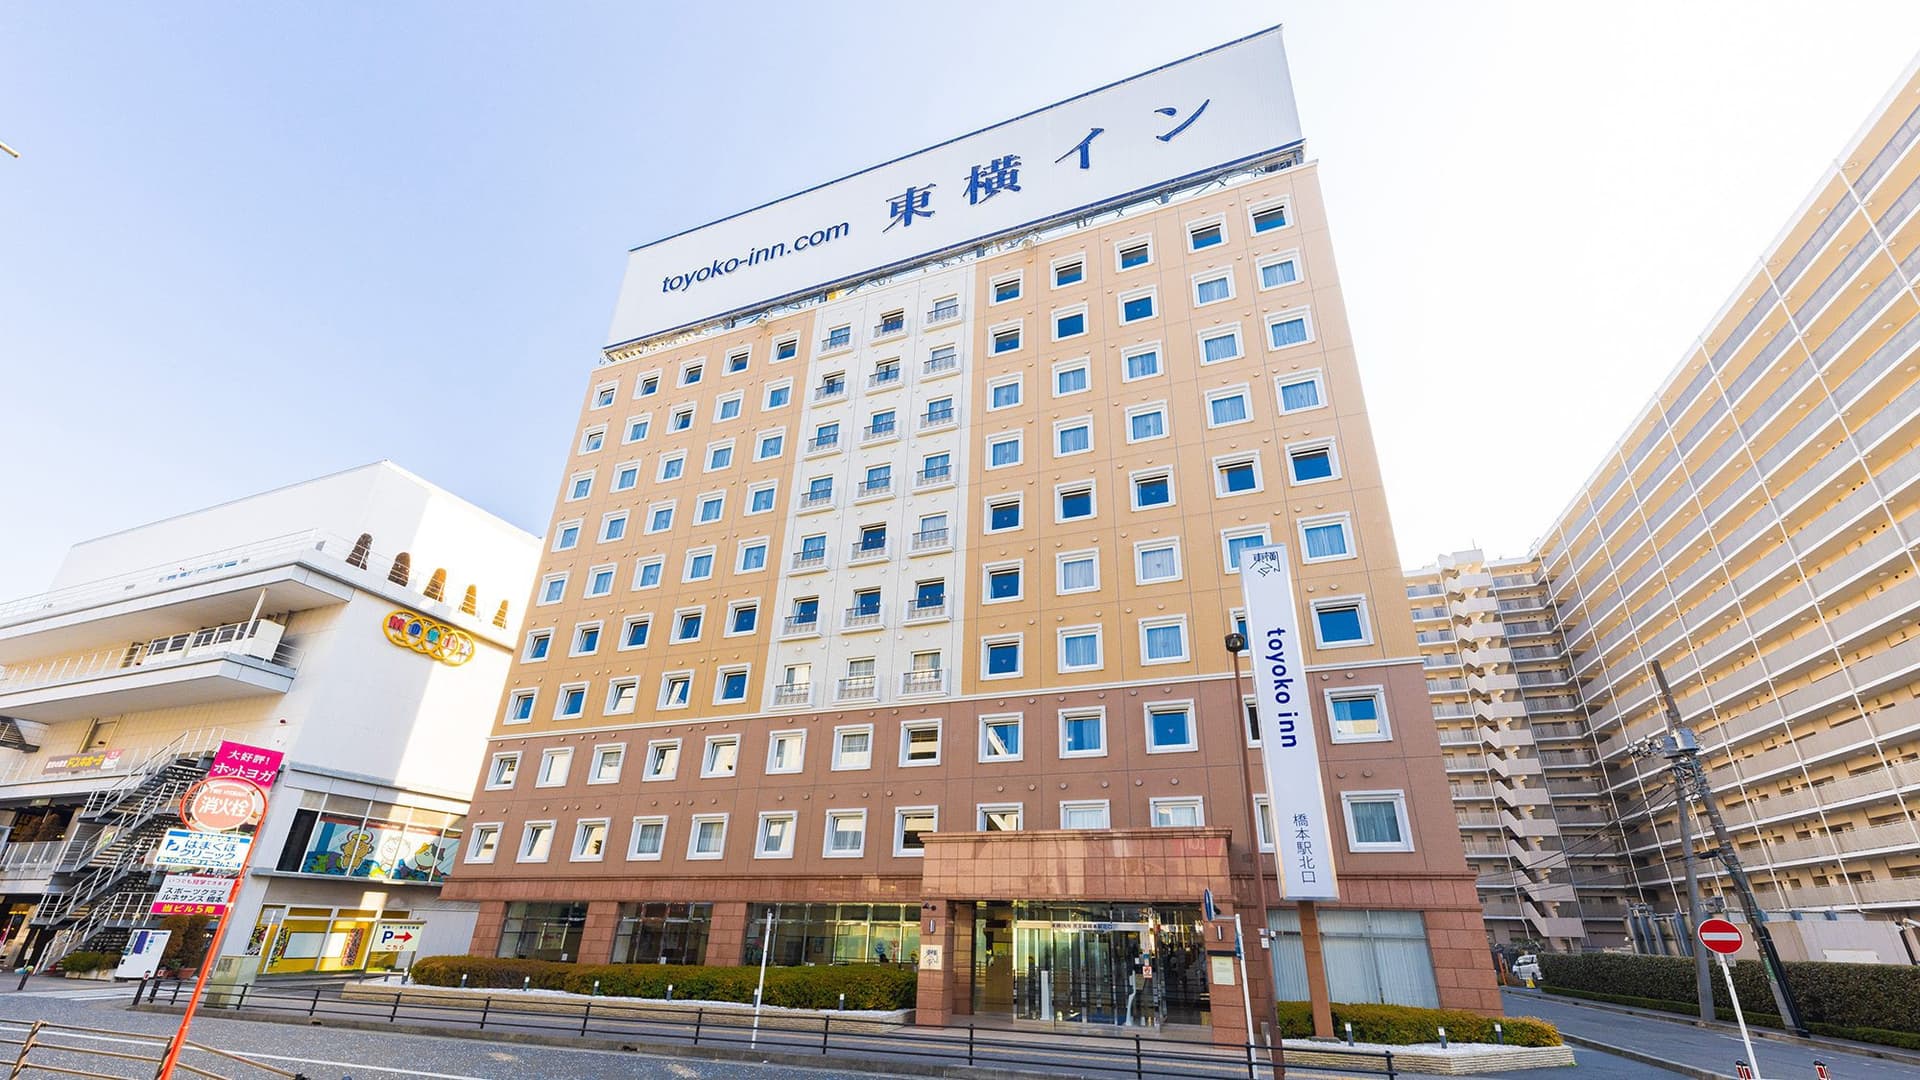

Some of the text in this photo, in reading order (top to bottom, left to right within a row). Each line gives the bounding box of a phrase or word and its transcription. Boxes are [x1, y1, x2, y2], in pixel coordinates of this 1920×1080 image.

[882, 98, 1211, 233] 東横イン
[662, 222, 850, 293] toyoko-inn.com
[1265, 627, 1299, 748] toyoko inn
[213, 762, 277, 783] ホットヨガ
[198, 796, 249, 817] 消火栓
[179, 848, 236, 860] クリニック
[1293, 813, 1316, 883] 橋本駅北口
[381, 930, 394, 944] P
